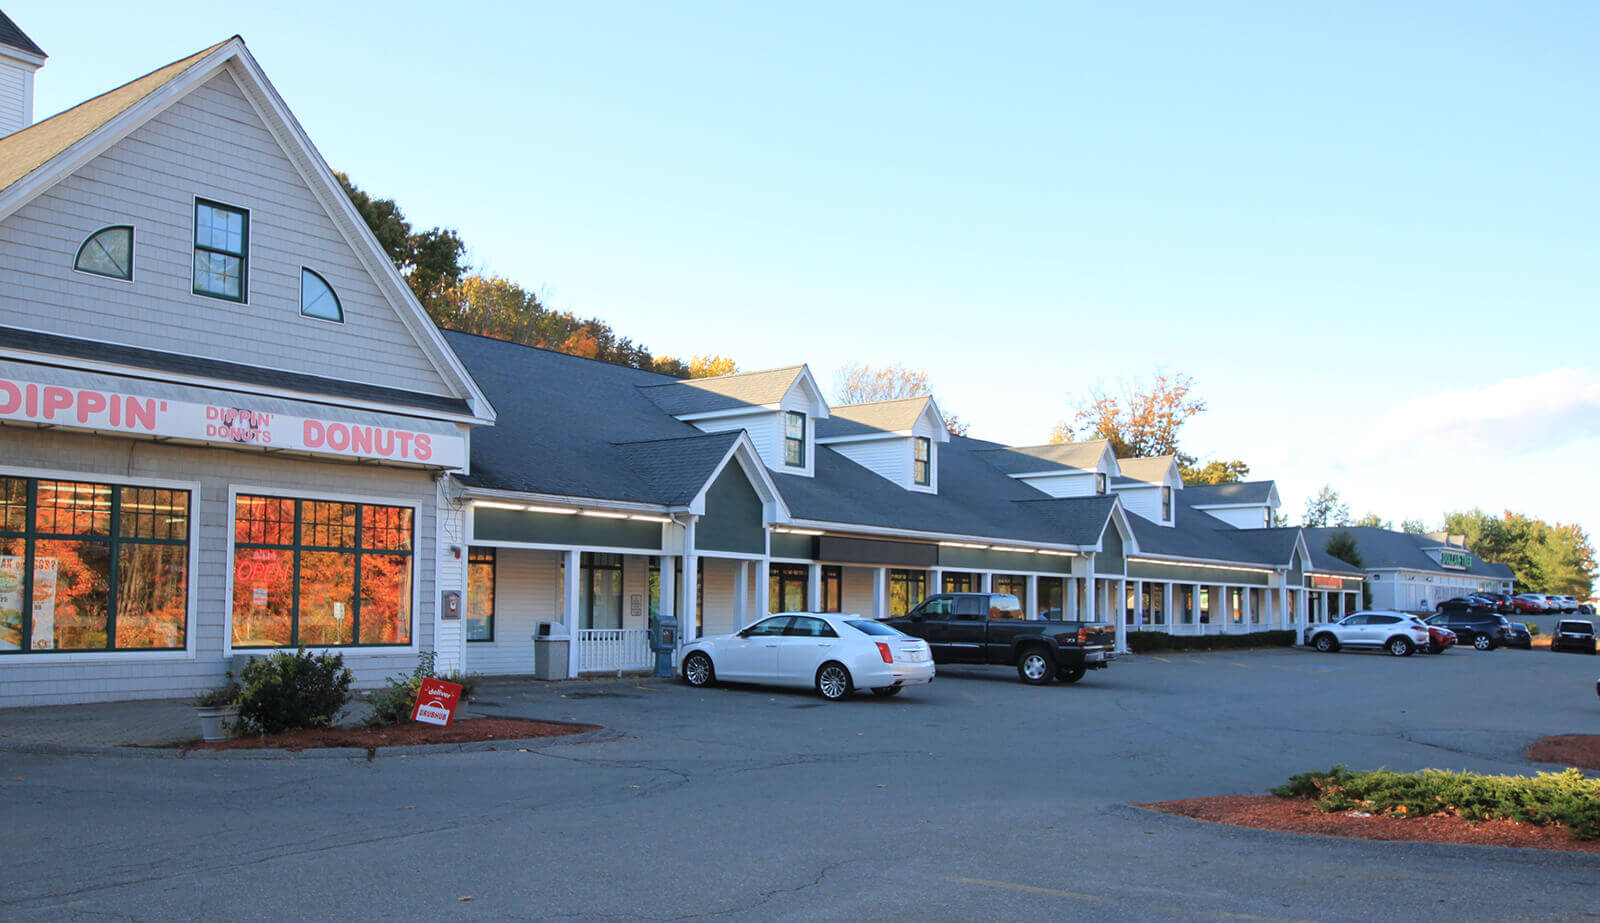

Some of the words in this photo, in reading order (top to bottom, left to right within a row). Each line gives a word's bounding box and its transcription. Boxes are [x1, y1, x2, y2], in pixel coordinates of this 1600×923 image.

[206, 406, 274, 427] DIPPIN'
[206, 423, 273, 443] DONUTS
[303, 419, 432, 461] DONUTS
[238, 561, 290, 583] OPEN
[428, 689, 451, 698] deliver
